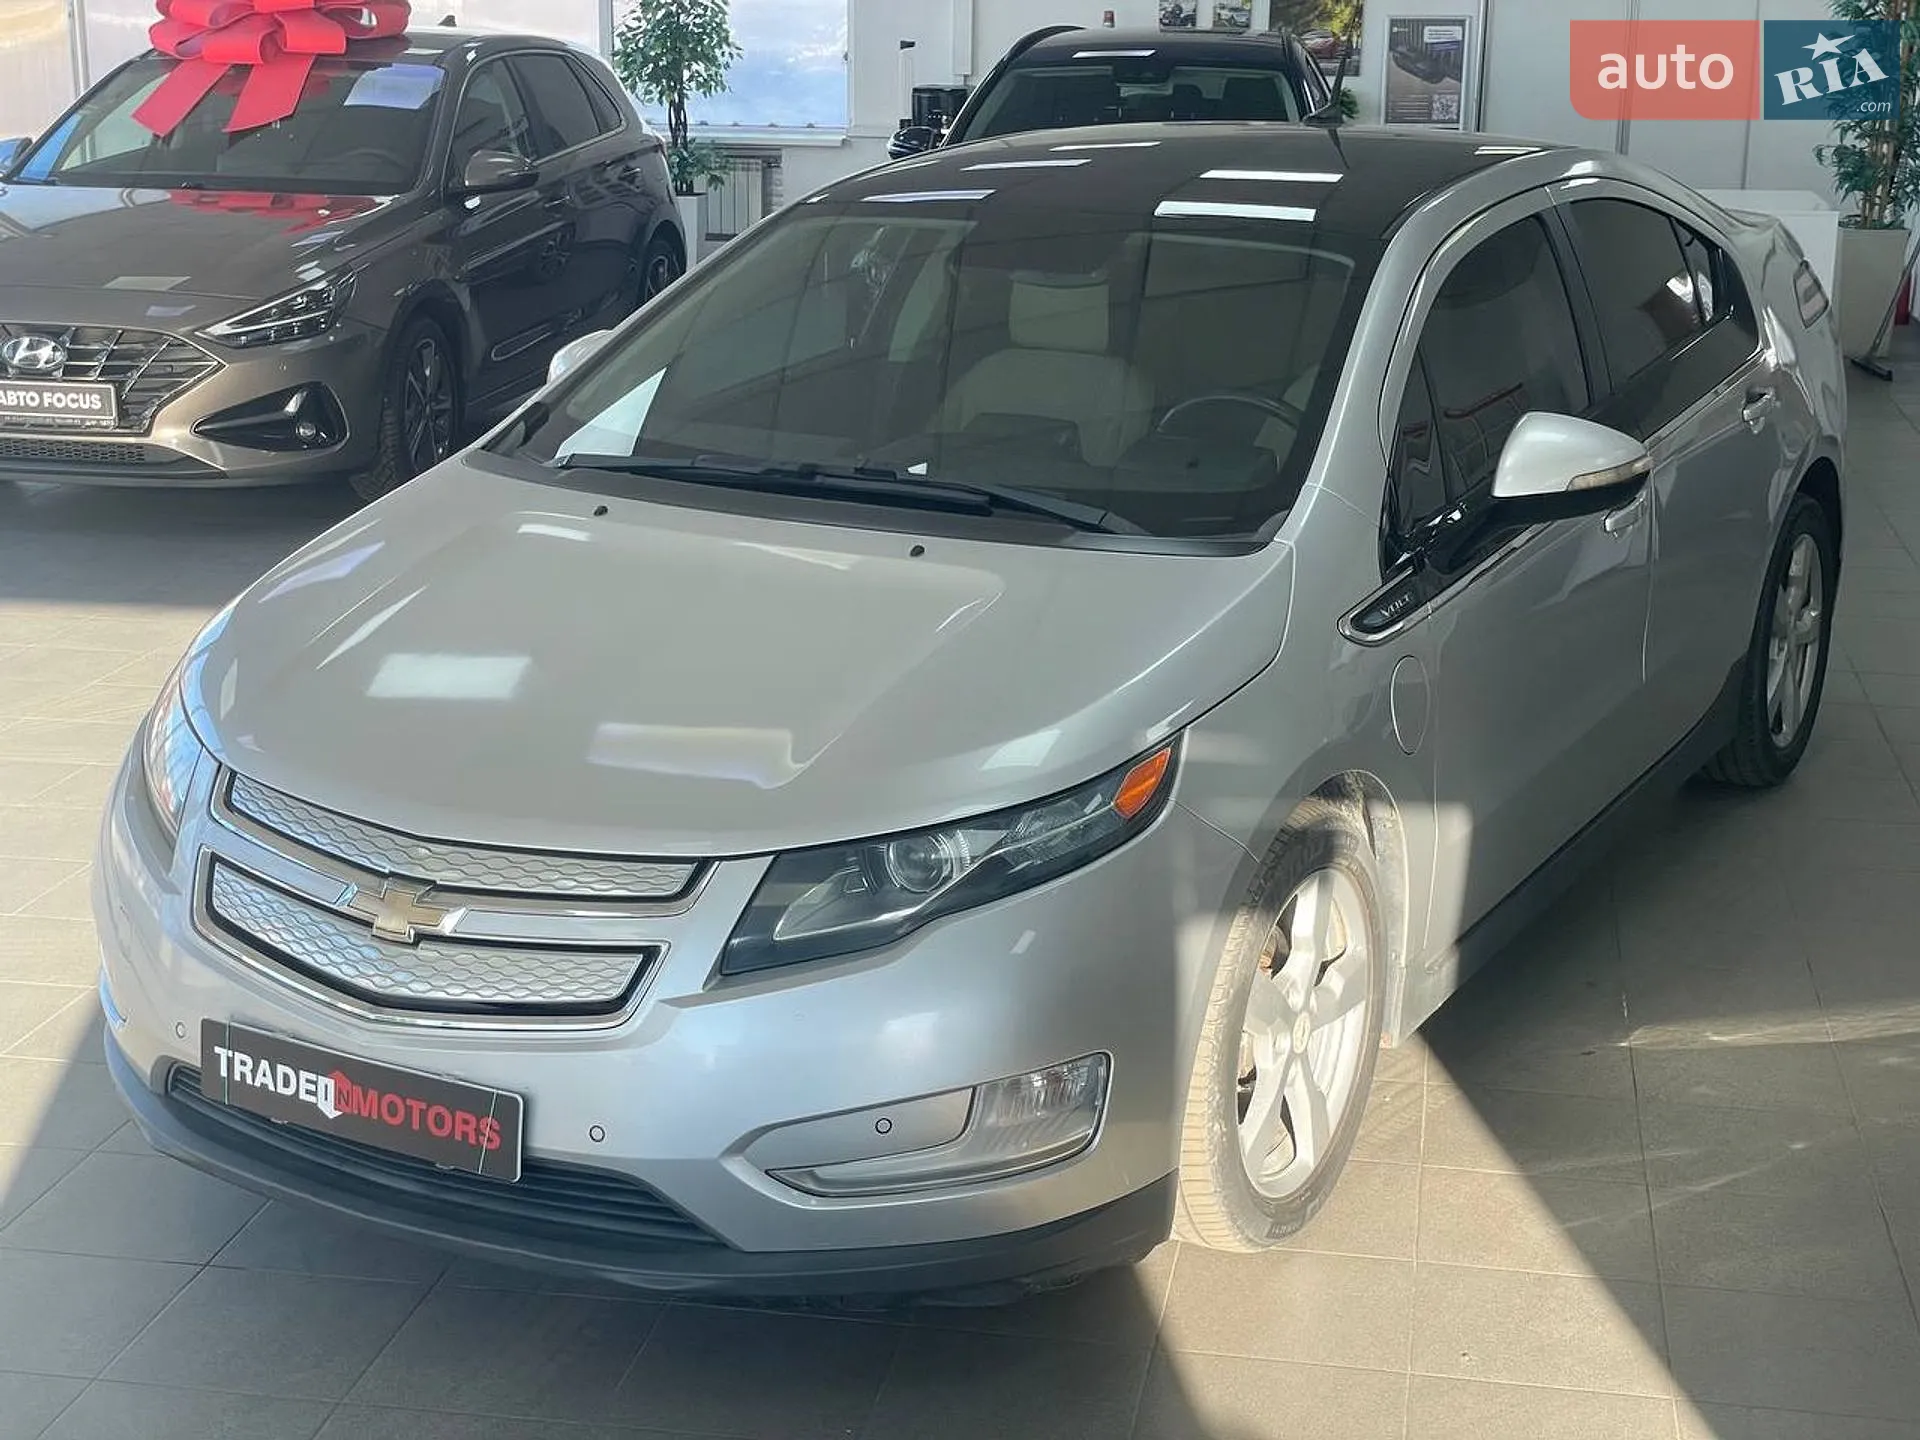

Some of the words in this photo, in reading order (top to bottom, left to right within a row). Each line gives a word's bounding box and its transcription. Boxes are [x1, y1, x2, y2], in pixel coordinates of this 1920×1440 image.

[42, 391, 102, 410] FOCUS
[214, 1046, 318, 1104] TRADE
[353, 1084, 501, 1150] MOTORS
